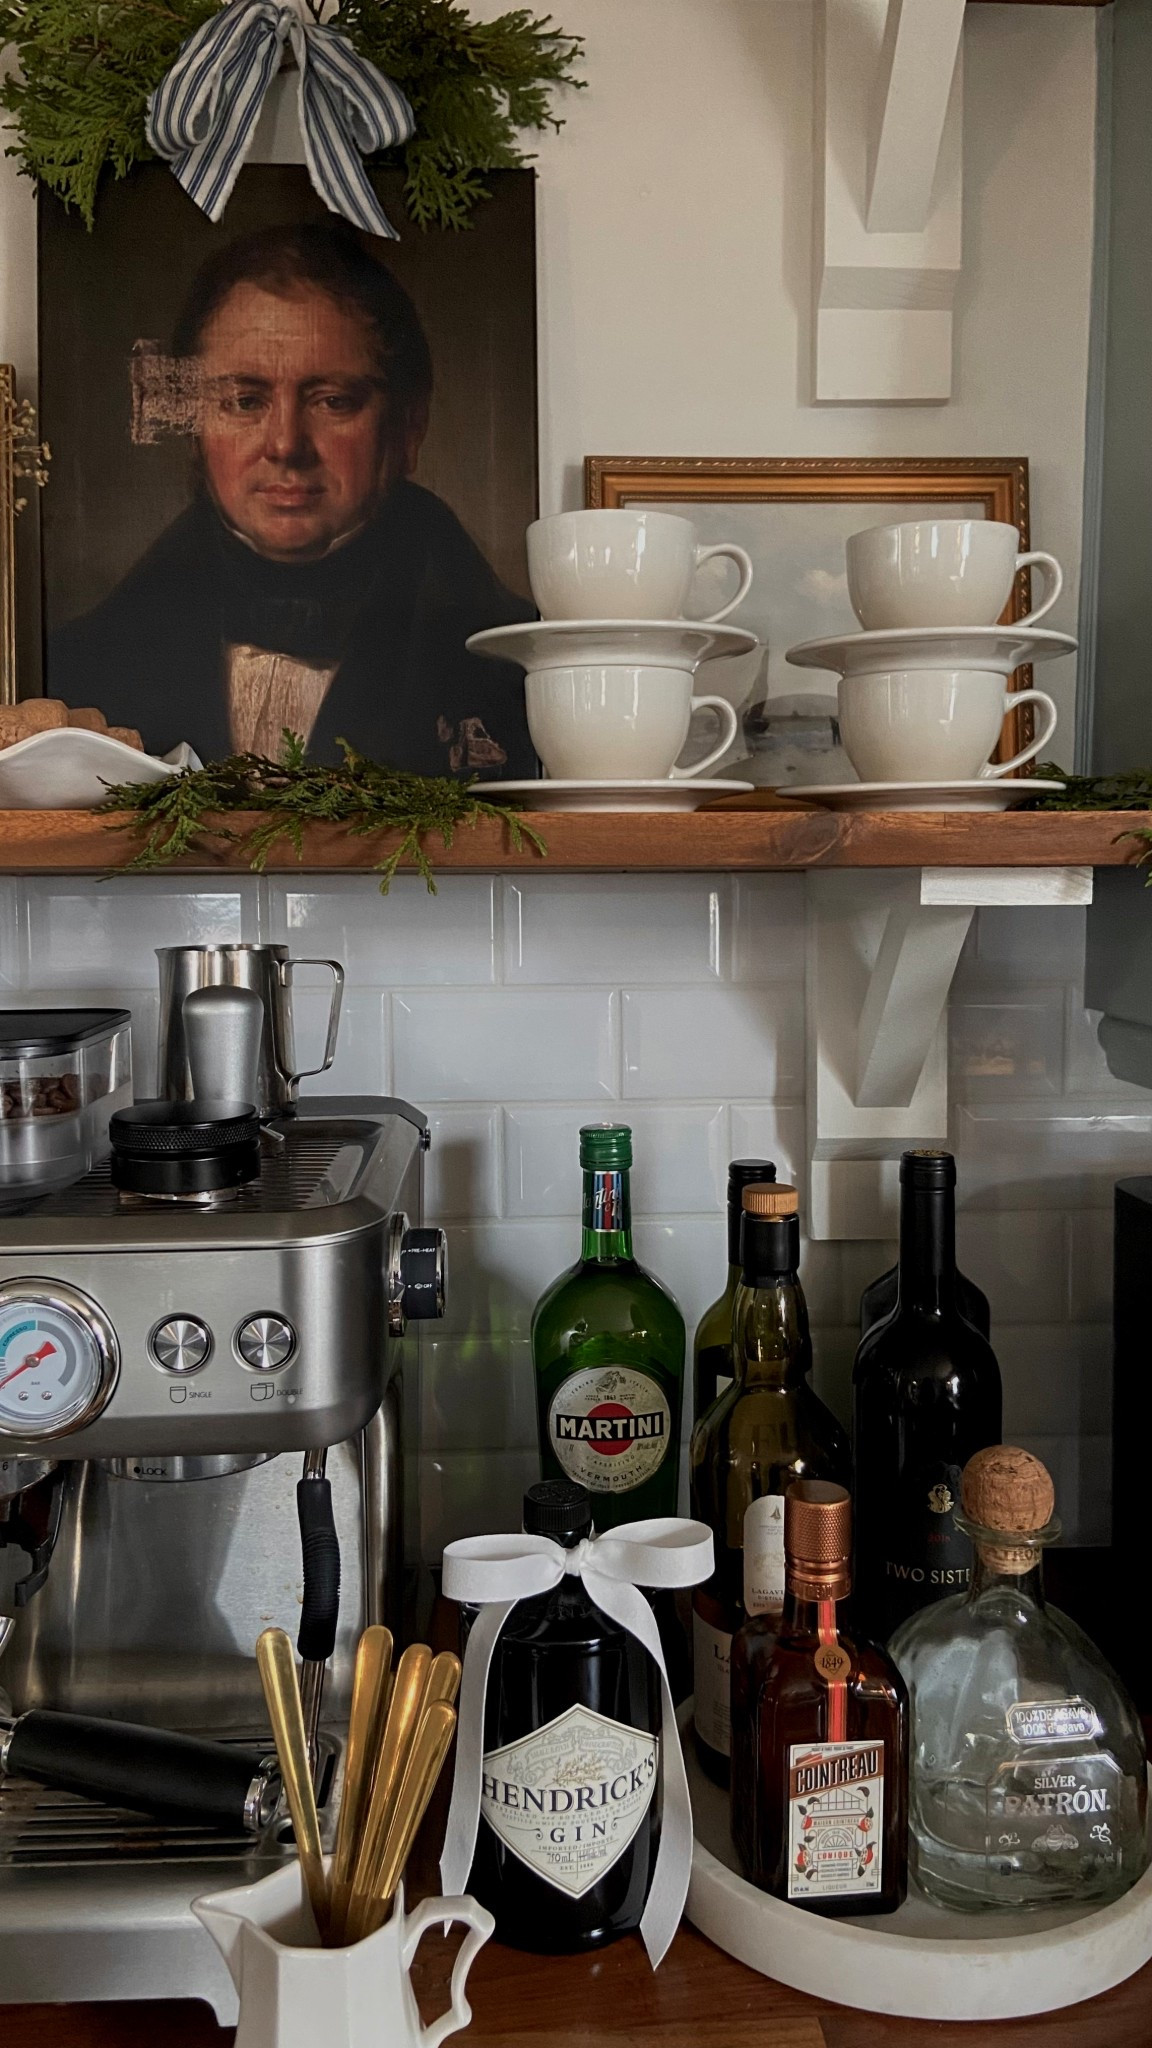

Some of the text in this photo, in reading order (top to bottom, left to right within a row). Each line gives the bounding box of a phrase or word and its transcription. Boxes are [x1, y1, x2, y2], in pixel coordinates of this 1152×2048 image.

[3, 1325, 28, 1347] ESPRESSO
[189, 1391, 212, 1399] SINGLE
[276, 1388, 303, 1396] DOUBLE
[560, 1415, 660, 1438] MARTINI
[141, 1467, 167, 1476] LOCK
[580, 1465, 642, 1482] VERMOUTH
[885, 1560, 925, 1583] TWO
[821, 1656, 844, 1670] 1849
[481, 1751, 655, 1813] HENDRICK'S
[796, 1750, 879, 1795] COINTREAU
[1034, 1775, 1076, 1789] SILVER
[1003, 1785, 1108, 1818] PATRÓN
[550, 1820, 607, 1844] GIN
